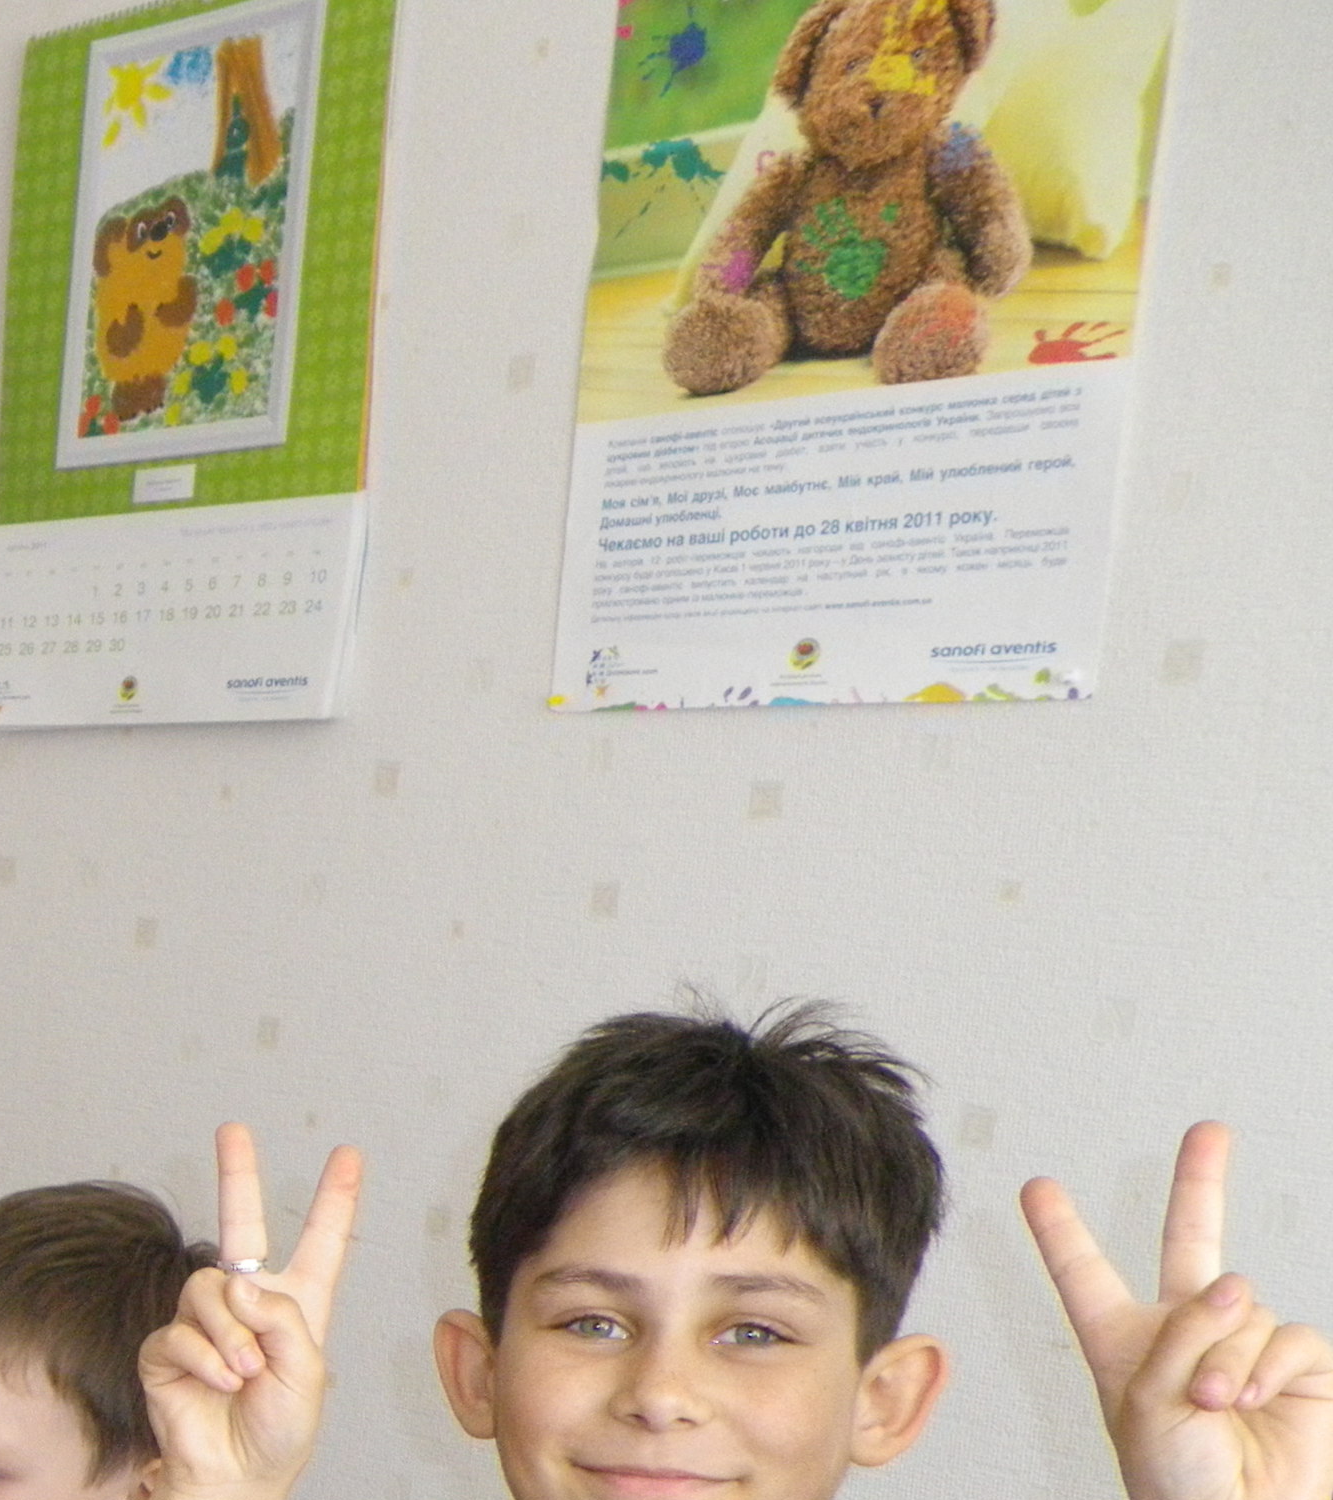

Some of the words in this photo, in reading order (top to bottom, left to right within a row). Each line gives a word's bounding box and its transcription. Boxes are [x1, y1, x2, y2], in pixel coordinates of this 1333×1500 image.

[597, 532, 663, 552] Чекаємо
[665, 530, 685, 548] на
[687, 527, 726, 546] ваші
[728, 523, 790, 544] роботи
[792, 522, 816, 539] до
[819, 520, 841, 538] 28
[843, 516, 898, 536] квітня
[902, 513, 942, 532] 2011
[947, 510, 999, 529] року.
[93, 586, 98, 597] 1
[114, 583, 123, 597] 2
[137, 581, 146, 596] 3
[161, 580, 169, 592] 4
[184, 578, 194, 592] 5
[208, 576, 218, 590] 6
[232, 574, 242, 588] 7
[257, 573, 267, 587] 8
[282, 571, 293, 586] 9
[310, 569, 328, 583] 10
[0, 617, 13, 629] 11
[23, 615, 37, 628] 12
[45, 614, 59, 627] 13
[67, 613, 82, 626] 14
[90, 612, 105, 625] 15
[113, 610, 127, 624] 16
[136, 609, 151, 622] 17
[159, 607, 175, 621] 18
[182, 606, 198, 620] 19
[205, 605, 221, 619] 20
[228, 604, 244, 618] 21
[252, 602, 271, 616] 22
[278, 600, 297, 615] 23
[304, 599, 323, 614] 24
[19, 642, 34, 656] 26
[41, 641, 57, 654] 27
[63, 640, 79, 653] 28
[85, 639, 102, 653] 29
[109, 638, 125, 652] 30
[930, 643, 986, 658] sanofi
[989, 640, 1058, 656] aventis
[226, 676, 263, 689] sanofi
[265, 674, 309, 688] aventis
